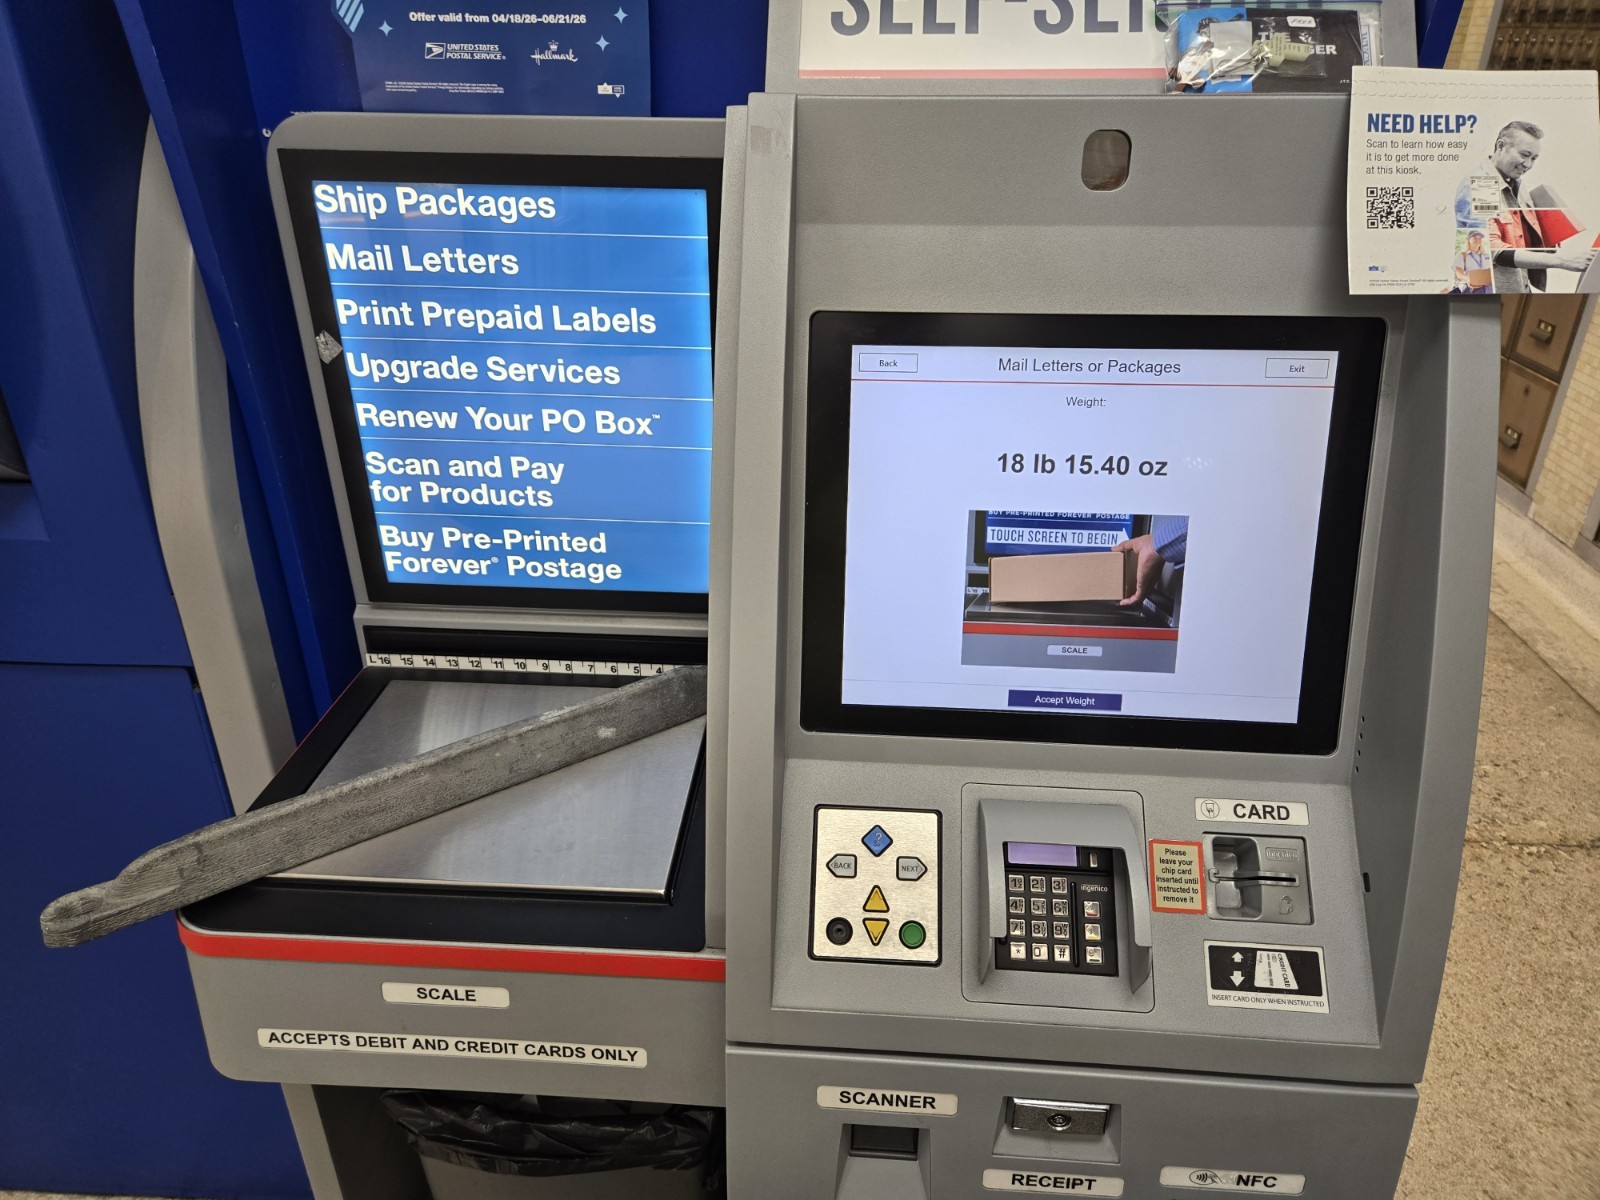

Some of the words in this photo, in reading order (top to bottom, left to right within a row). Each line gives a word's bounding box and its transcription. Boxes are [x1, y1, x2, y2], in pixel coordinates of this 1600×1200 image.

[409, 11, 436, 22] Offer
[438, 12, 463, 22] valid
[464, 13, 490, 23] from
[447, 43, 474, 51] UNITED
[446, 52, 473, 60] POSTAL
[530, 48, 578, 66] Hallmark
[1367, 113, 1415, 133] NEED
[1419, 114, 1478, 134] HELP?
[1366, 139, 1388, 149] Scan
[1391, 140, 1399, 149] to
[1402, 140, 1423, 149] learn
[1426, 140, 1445, 149] how
[1447, 141, 1468, 150] easy
[1366, 152, 1372, 161] it
[1374, 153, 1382, 161] is
[1384, 153, 1393, 161] to
[1395, 153, 1410, 163] get
[1412, 154, 1435, 162] more
[1437, 152, 1460, 162] done
[1365, 166, 1374, 174] at
[1377, 166, 1393, 174] this
[1396, 165, 1421, 175] kiosk.
[315, 184, 387, 219] Ship
[396, 186, 556, 224] Packages
[325, 242, 394, 271] Mail
[402, 245, 519, 275] Letters
[336, 298, 414, 326] Print
[421, 301, 543, 334] Prepaid
[552, 305, 657, 333] Labels
[346, 352, 478, 384] Upgrade
[487, 356, 620, 385] Services
[878, 358, 898, 368] Back
[998, 358, 1028, 372] Mail
[1033, 358, 1083, 373] Letters
[1088, 362, 1104, 373] or
[1107, 359, 1182, 376] Packages
[1289, 364, 1306, 374] Exit
[1066, 396, 1107, 410] Weight:
[355, 403, 458, 429] Renew
[465, 406, 533, 431] Your
[541, 409, 586, 433] PO
[365, 451, 440, 475] Scan
[448, 456, 502, 478] and
[510, 456, 565, 484] Pay
[997, 454, 1025, 473] 18
[1033, 454, 1056, 474] lb
[1064, 455, 1130, 475] 15.40
[1138, 460, 1168, 476] oz
[370, 480, 412, 502] for
[419, 482, 554, 507] Products
[379, 525, 434, 551] Buy
[441, 527, 607, 553] Pre-Printed
[991, 529, 1024, 542] TOUCH
[1028, 530, 1068, 543] SCREEN
[1072, 532, 1084, 544] TO
[1087, 532, 1118, 545] BEGIN
[507, 555, 622, 583] Postage
[1061, 647, 1088, 655] SCALE
[369, 655, 376, 663] L
[379, 656, 390, 665] 16
[401, 657, 413, 666] 15
[424, 658, 435, 667] 14
[447, 659, 458, 667] 13
[469, 660, 481, 668] 12
[493, 661, 503, 669] 11
[515, 661, 526, 670] 10
[542, 663, 549, 671] 9
[565, 664, 572, 672] 8
[588, 665, 594, 673] 7
[1035, 695, 1064, 706] Accept
[1066, 696, 1095, 707] Weight
[1233, 803, 1290, 821] CARD
[1165, 848, 1187, 856] Please
[834, 861, 851, 870] BACK
[1160, 857, 1176, 865] leave
[901, 865, 919, 873] NEXT
[1162, 867, 1176, 875] chip
[1032, 880, 1039, 889] 2
[1156, 875, 1183, 884] inserted
[1053, 881, 1061, 890] 3
[1081, 884, 1108, 893] ingenico
[1157, 885, 1190, 894] instructed
[1011, 901, 1018, 910] 4
[1033, 901, 1040, 911] 5
[1054, 903, 1061, 913] 6
[1011, 922, 1018, 932] 7
[1033, 924, 1040, 934] 8
[1055, 925, 1062, 935] 9
[1034, 947, 1041, 957] 0
[1278, 953, 1287, 972] CREDIT
[1282, 973, 1290, 987] CARD
[416, 987, 477, 1002] SCALE
[1287, 999, 1324, 1007] INSTRUCTED
[268, 1032, 351, 1047] ACCEPTS
[355, 1035, 408, 1050] DEBIT
[412, 1037, 450, 1052] AND
[454, 1040, 519, 1056] CREDIT
[524, 1043, 587, 1059] CARDS
[591, 1047, 639, 1063] ONLY
[839, 1090, 937, 1110] SCANNER
[1011, 1174, 1096, 1192] RECEIPT
[1236, 1174, 1278, 1189] NFC
